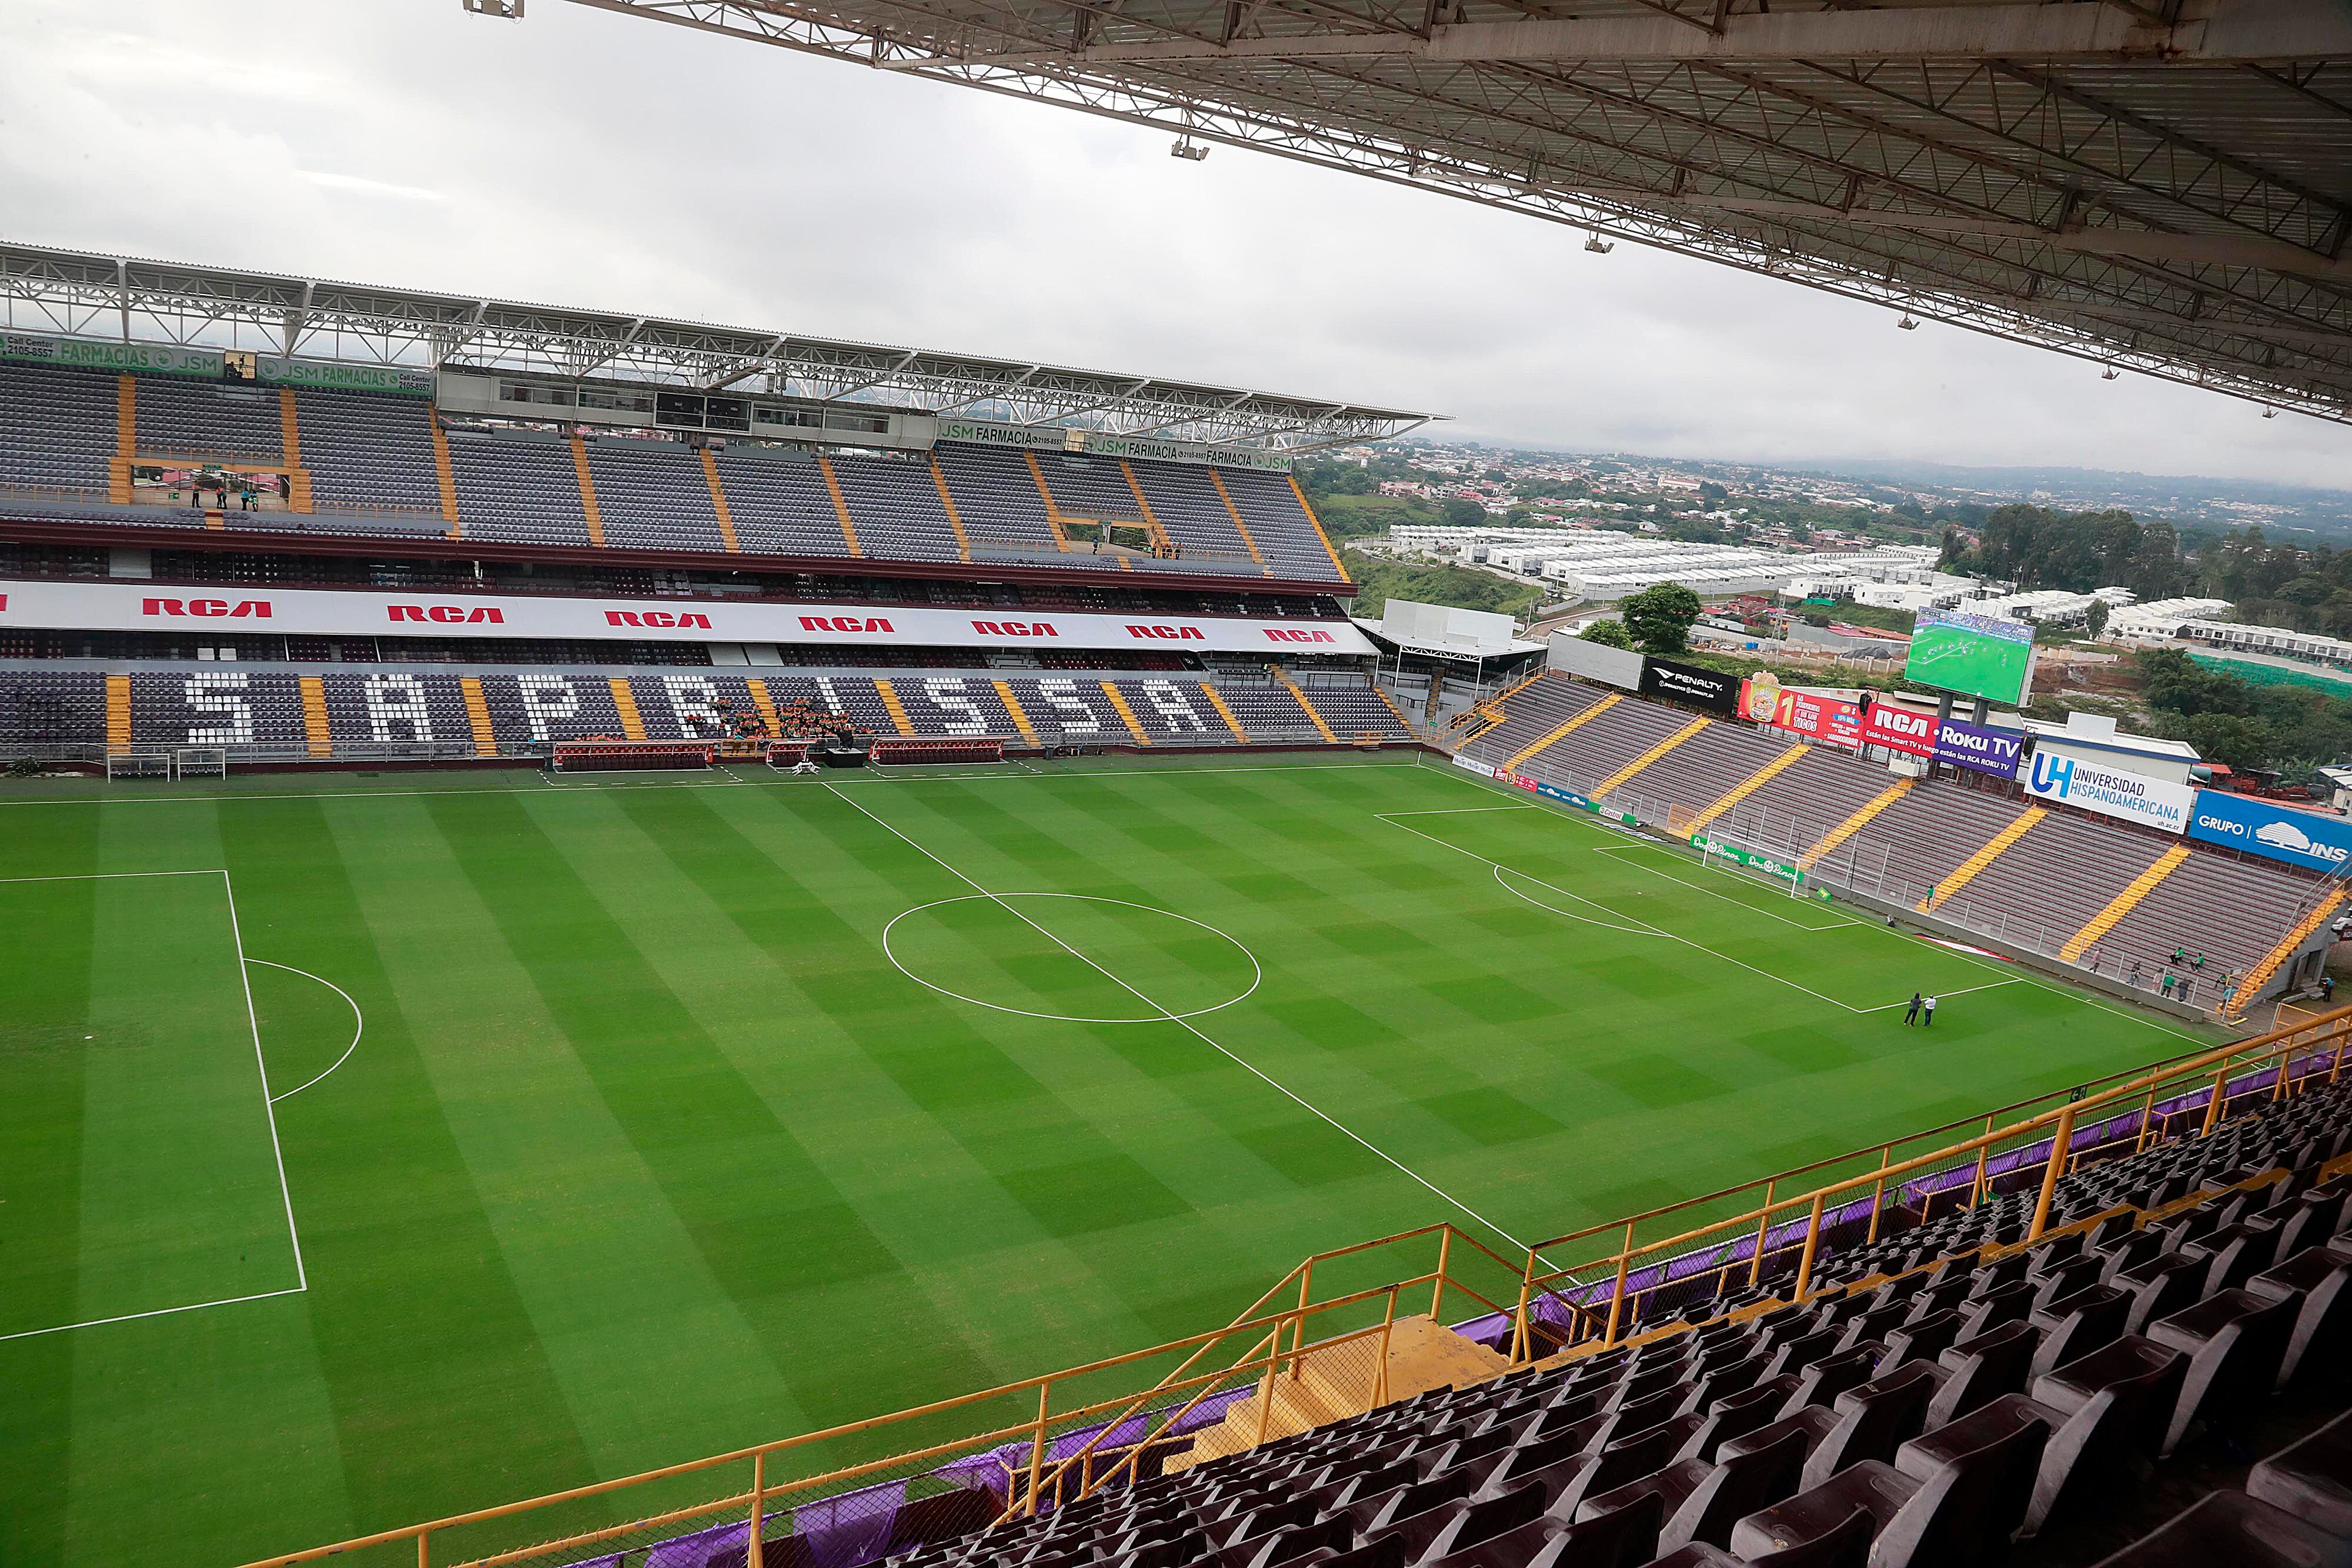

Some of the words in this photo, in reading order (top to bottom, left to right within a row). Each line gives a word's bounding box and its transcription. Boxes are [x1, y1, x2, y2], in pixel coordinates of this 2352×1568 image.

[8, 337, 24, 345] Call
[28, 339, 53, 347] Center
[8, 345, 53, 357] 2105-8557
[61, 341, 149, 367] FARMACIAS
[178, 356, 217, 372] JSM
[283, 365, 318, 380] JSM
[323, 367, 386, 386] FARMACIAS
[399, 382, 430, 392] 2105-8557
[942, 424, 973, 439] JSM
[976, 427, 1032, 445] FARMACIA
[1038, 437, 1062, 445] 2105-8557
[1097, 440, 1127, 454] JSM
[1128, 443, 1177, 459] FARMACIA
[1206, 450, 1252, 466] FARMACIA
[1265, 457, 1291, 470] JSM
[143, 598, 272, 618] RCA
[387, 605, 505, 624] RCA
[604, 610, 711, 628] RCA
[798, 616, 894, 633] RCA
[971, 620, 1058, 636] RCA
[1124, 624, 1205, 640] RCA
[1262, 628, 1335, 643] RCA
[1793, 717, 1818, 732] TICOS
[1874, 709, 1928, 737] RCA
[1992, 737, 2020, 758] TV
[1866, 730, 1881, 739] Están
[1891, 737, 1908, 746] Smart
[1922, 744, 1939, 754] luego
[1940, 748, 1956, 759] están
[1957, 753, 1966, 761] las
[1967, 755, 1980, 764] RCA
[1980, 758, 2000, 768] ROKU
[2000, 763, 2010, 771] TV
[2031, 753, 2074, 799] UH
[2074, 767, 2145, 796] UNIVERSIDAD
[2070, 782, 2179, 821] HISPANOAMERICANA
[1604, 808, 1622, 820] Castrol
[2157, 820, 2179, 831] uh.ac.cr
[2199, 815, 2244, 835] GRUPO
[2309, 842, 2349, 861] INS
[1693, 837, 1707, 849] Dos
[1717, 845, 1740, 861] Pinos
[1749, 856, 1764, 869] Dos
